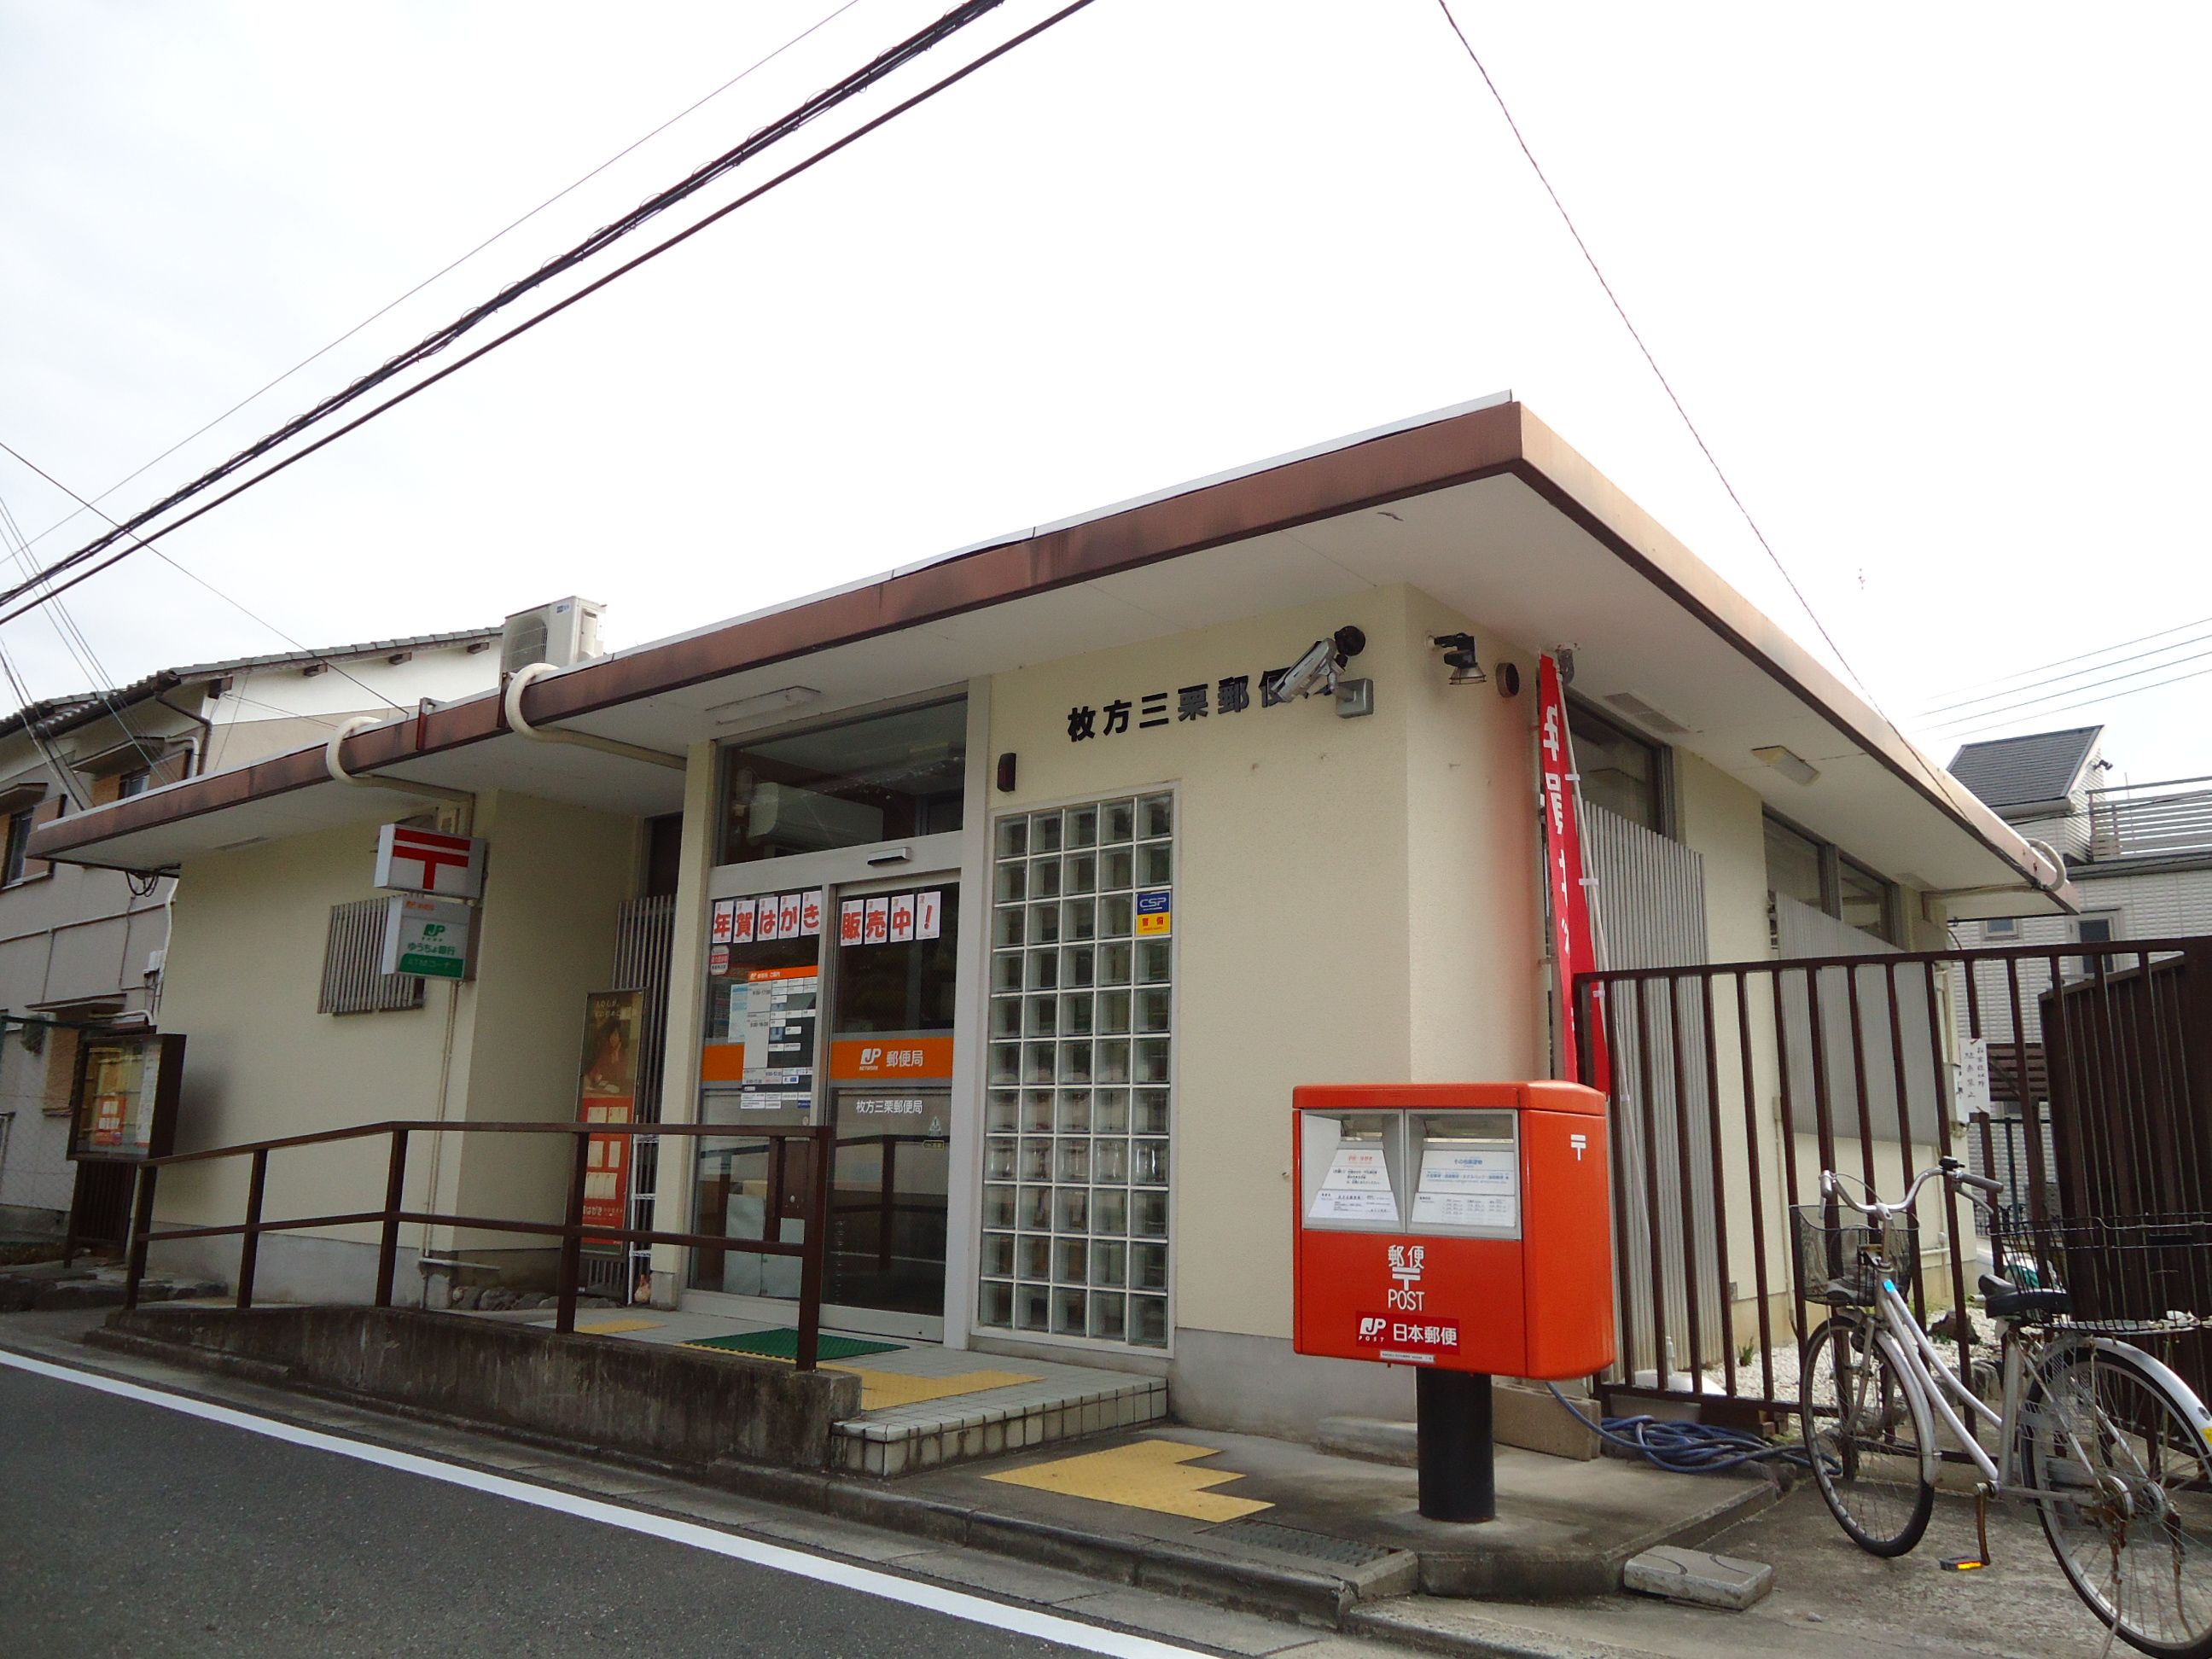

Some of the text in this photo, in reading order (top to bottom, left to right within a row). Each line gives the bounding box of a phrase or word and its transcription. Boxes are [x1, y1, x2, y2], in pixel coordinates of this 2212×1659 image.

[1139, 897, 1167, 908] CSP
[713, 904, 820, 938] 年賀はがき
[407, 942, 456, 956] ゆうちょ銀行
[860, 1048, 882, 1065] JP
[886, 1050, 923, 1068] 郵便局
[856, 1099, 923, 1114] 枚方三栗郵便局
[1388, 1245, 1425, 1270] 郵便
[1388, 1289, 1425, 1312] POST
[1359, 1318, 1387, 1336] JP
[1393, 1323, 1458, 1347] 日本郵便
